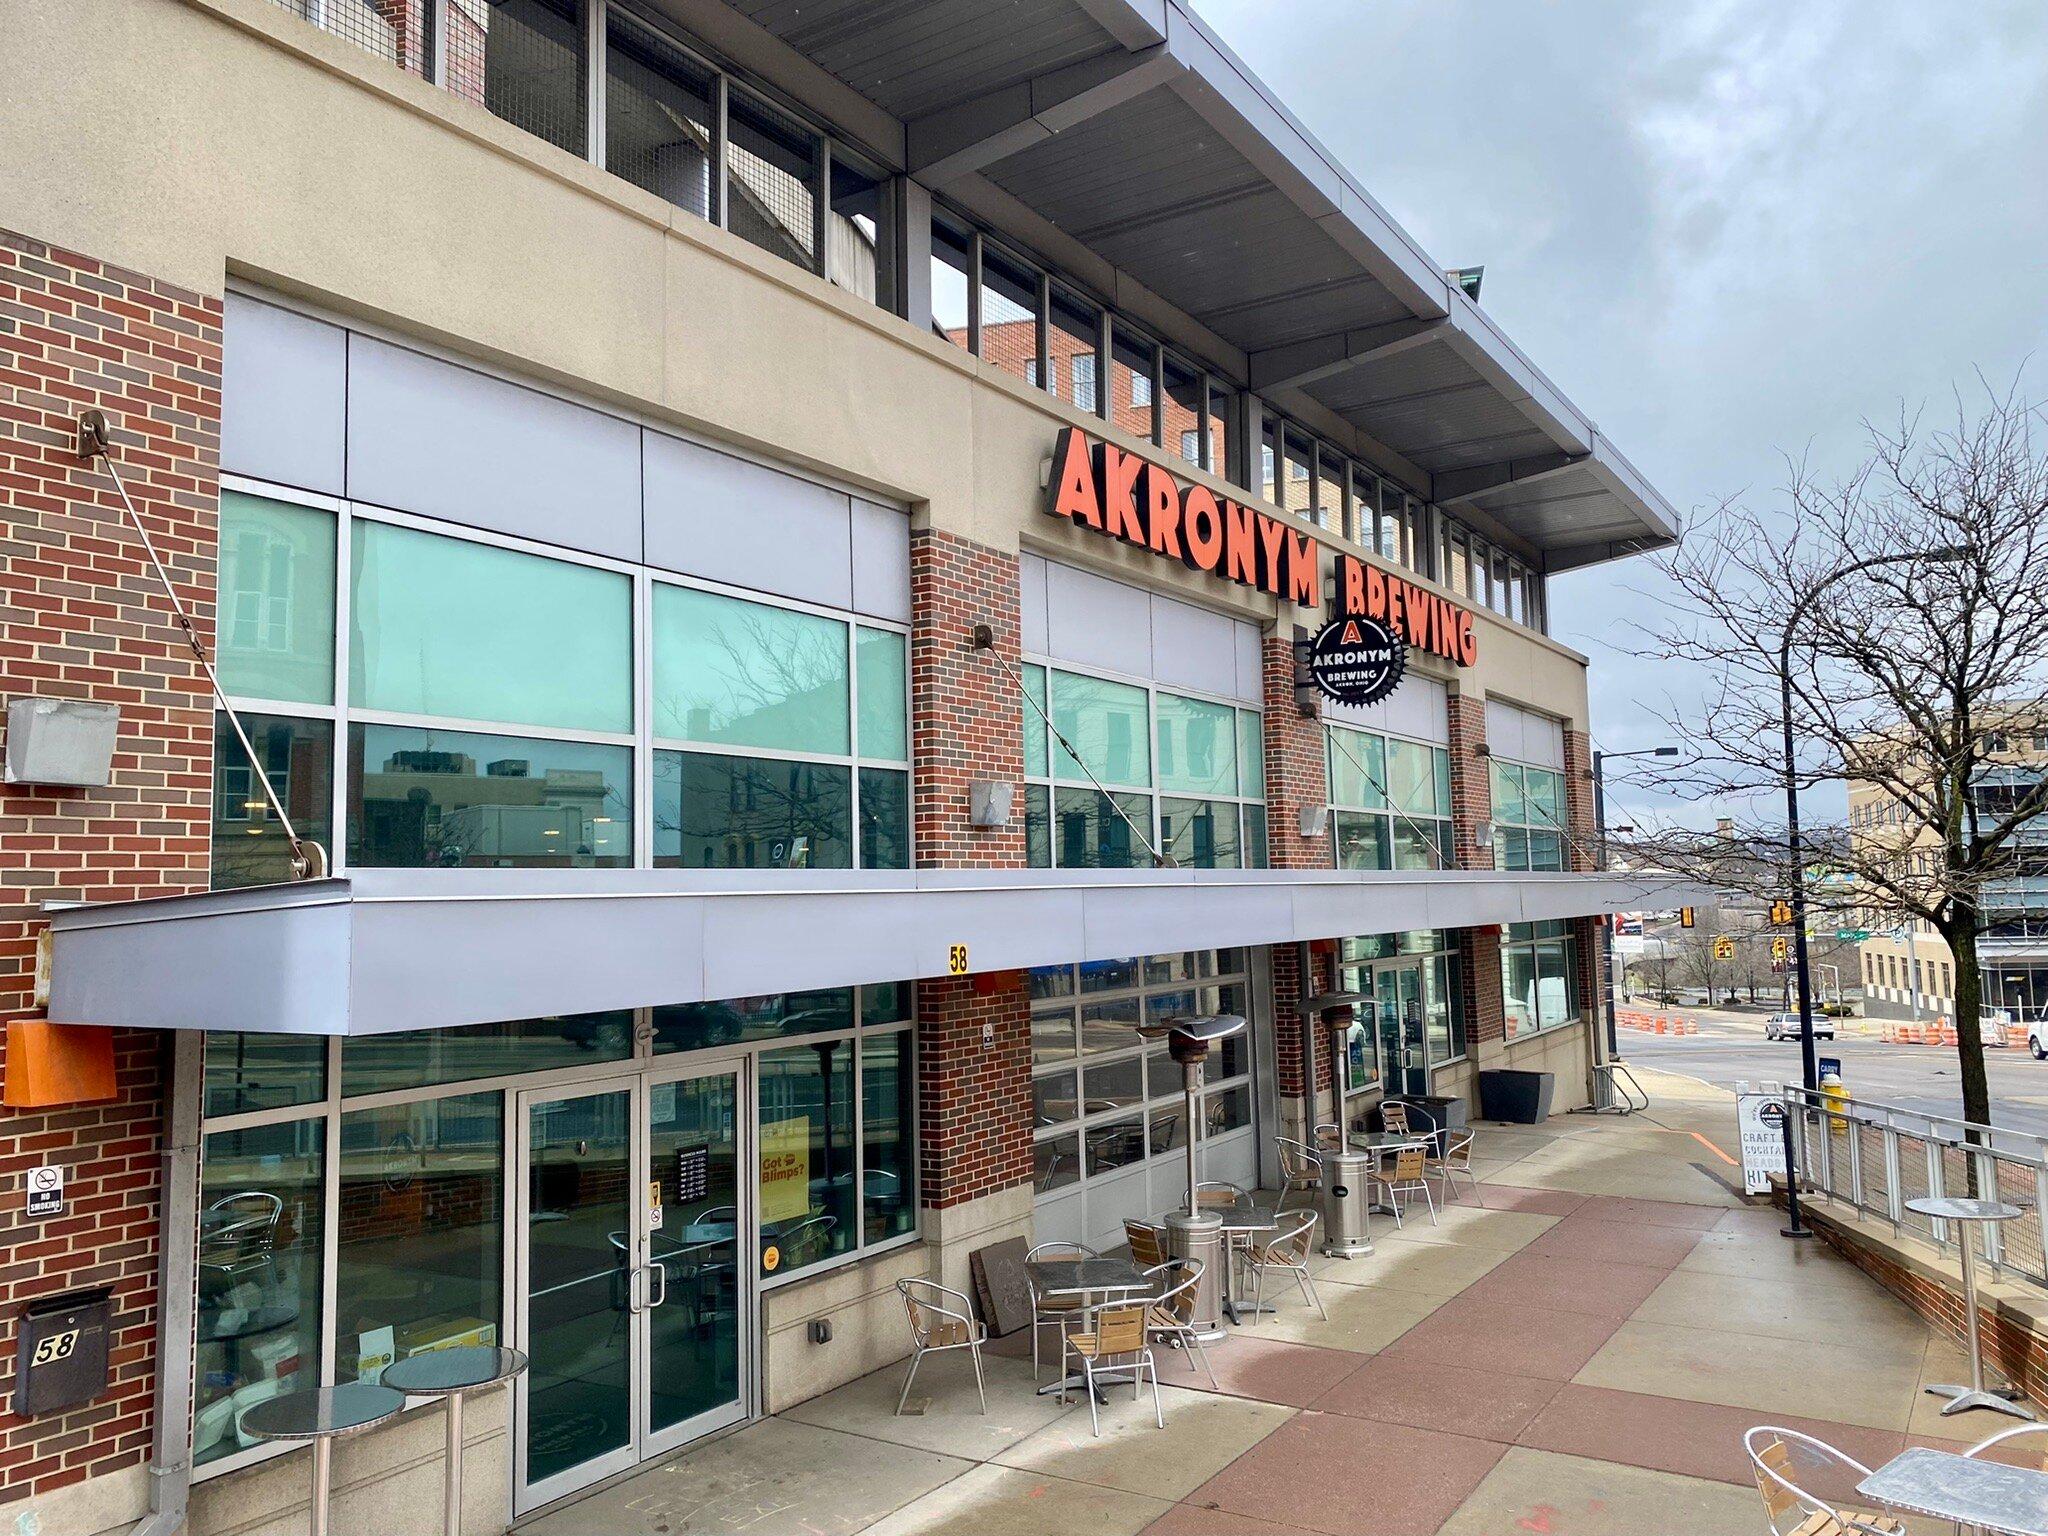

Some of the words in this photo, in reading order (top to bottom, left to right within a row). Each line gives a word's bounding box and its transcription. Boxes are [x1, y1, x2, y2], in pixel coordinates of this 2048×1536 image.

[1053, 426, 1319, 608] AKRONYM
[1344, 553, 1477, 668] BREWING
[1340, 620, 1363, 645] A
[1312, 648, 1392, 667] AKRONYM
[1327, 669, 1377, 682] BREWING
[949, 945, 968, 973] 58
[1743, 1133, 1776, 1143] CRAFT
[762, 1156, 782, 1170] Got
[762, 1164, 804, 1183] Blimps?
[30, 1200, 60, 1211] SMOKING
[40, 1192, 51, 1201] NO
[36, 1333, 74, 1363] 58
